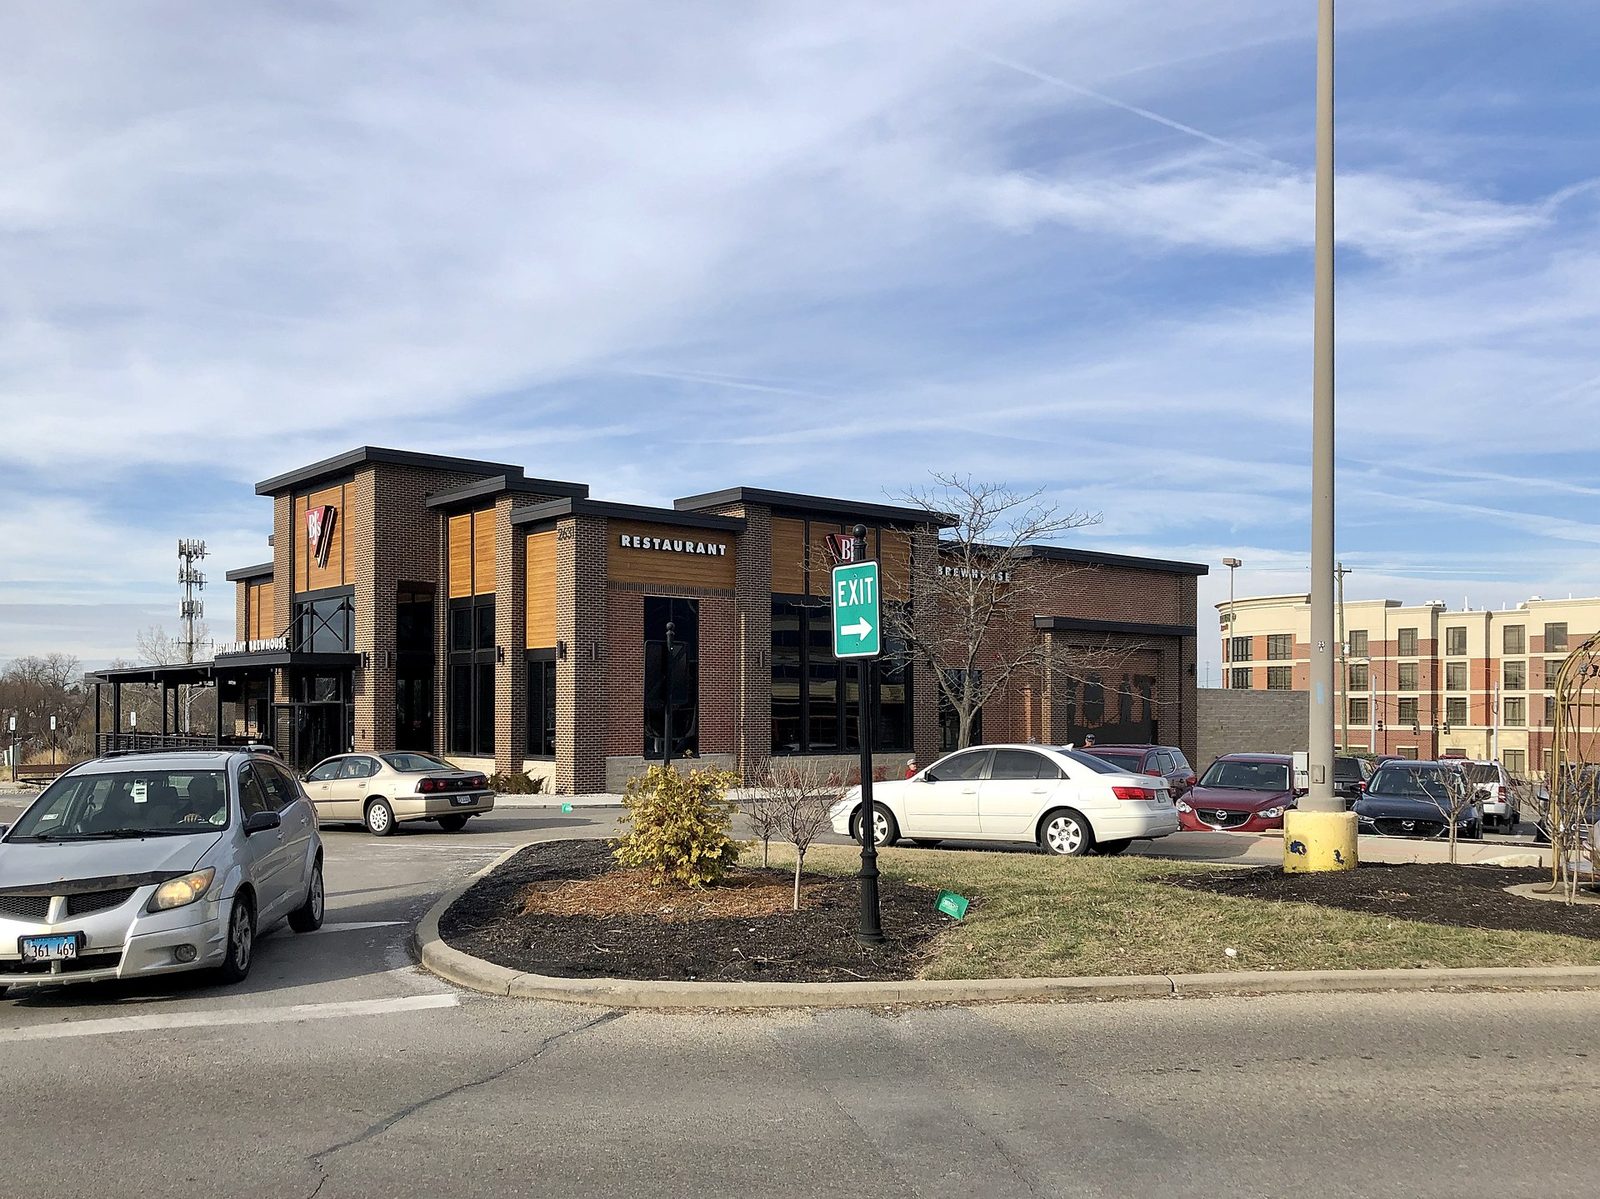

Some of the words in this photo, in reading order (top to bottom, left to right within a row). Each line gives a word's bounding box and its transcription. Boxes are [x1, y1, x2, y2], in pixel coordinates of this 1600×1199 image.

[621, 534, 726, 556] RESTAURANT
[837, 577, 874, 607] EXIT
[31, 943, 50, 958] 361
[56, 942, 75, 956] 469
